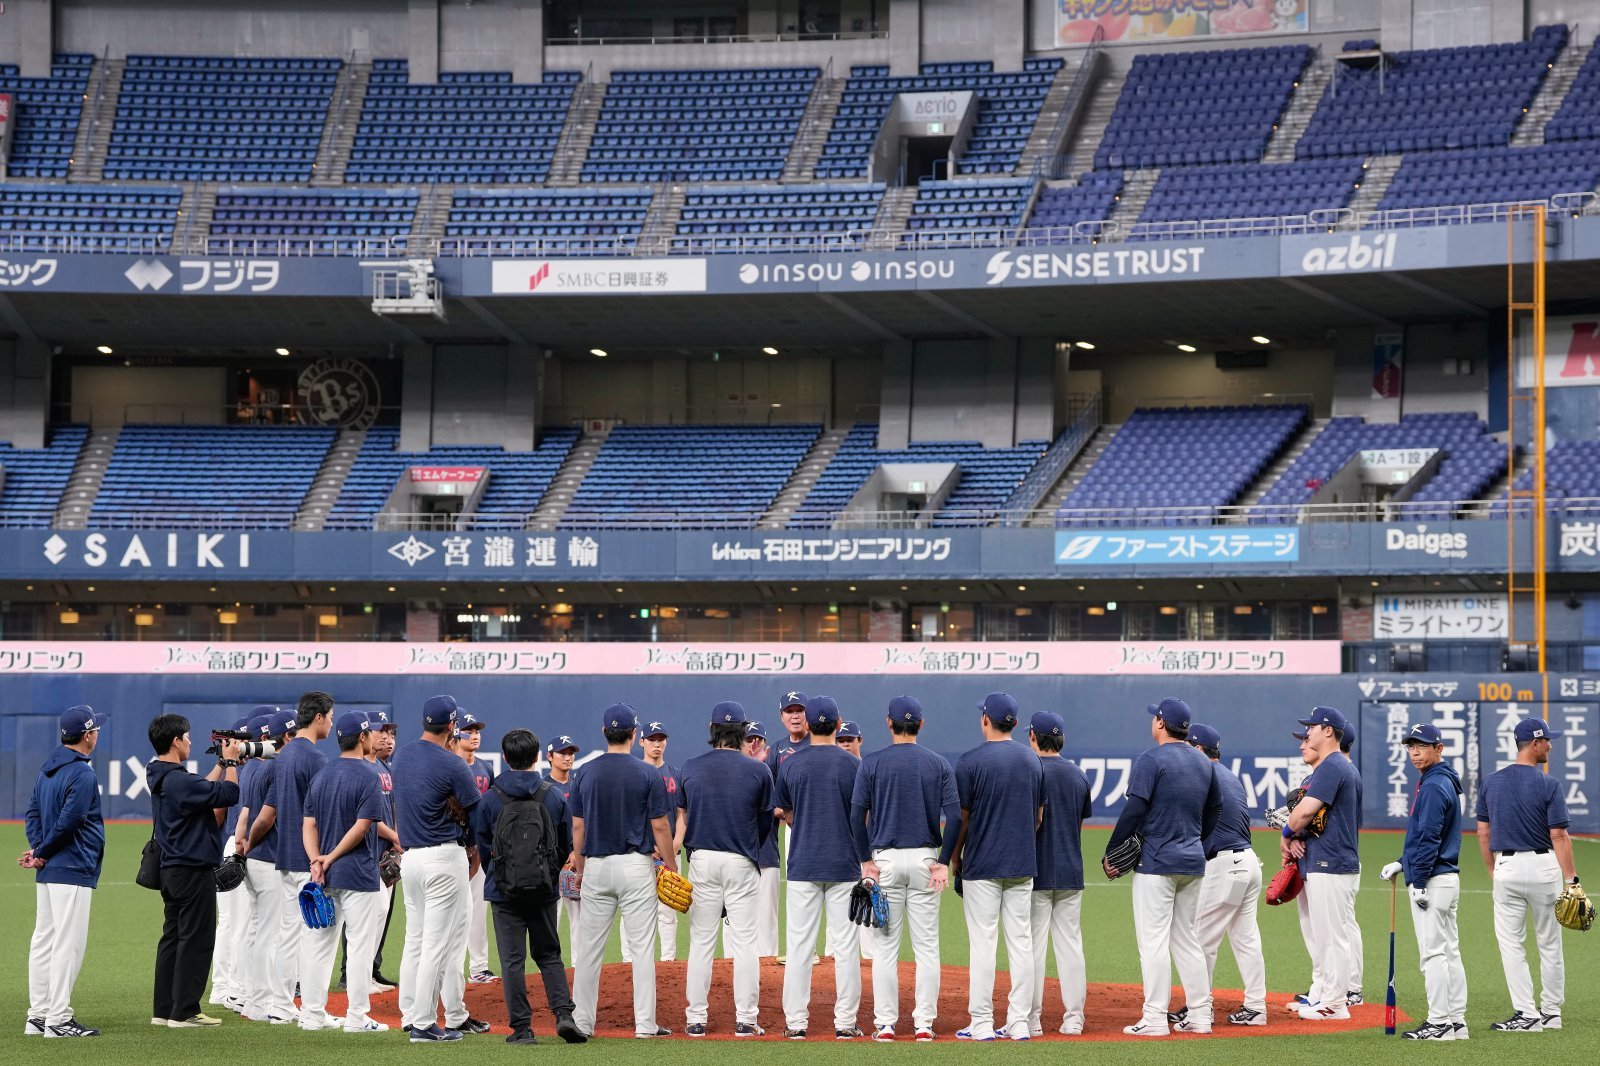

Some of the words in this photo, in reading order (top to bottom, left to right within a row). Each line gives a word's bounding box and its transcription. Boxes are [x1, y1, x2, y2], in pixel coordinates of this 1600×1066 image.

[1015, 251, 1110, 279] SENSE
[1114, 247, 1204, 275] TRUST
[1302, 233, 1397, 272] azbil
[180, 260, 280, 292] フジタ
[84, 533, 250, 567] SAIKI
[763, 538, 952, 561] 石田エンジニアリング
[1106, 533, 1296, 558] ファーストステージ
[1386, 525, 1468, 554] Daigas
[1404, 598, 1459, 610] MIRAIT
[1463, 598, 1500, 610] ONE
[208, 652, 329, 671] 高須クリニック
[449, 652, 566, 671] 高須クリニック
[686, 652, 805, 671] 高須クリニック
[923, 652, 1041, 671] 高須クリニック
[1162, 652, 1285, 671] 高須クリニック
[1378, 681, 1459, 698] アーキヤマデ
[1478, 682, 1512, 701] 100
[1517, 689, 1534, 701] m
[1563, 715, 1588, 805] エレコム
